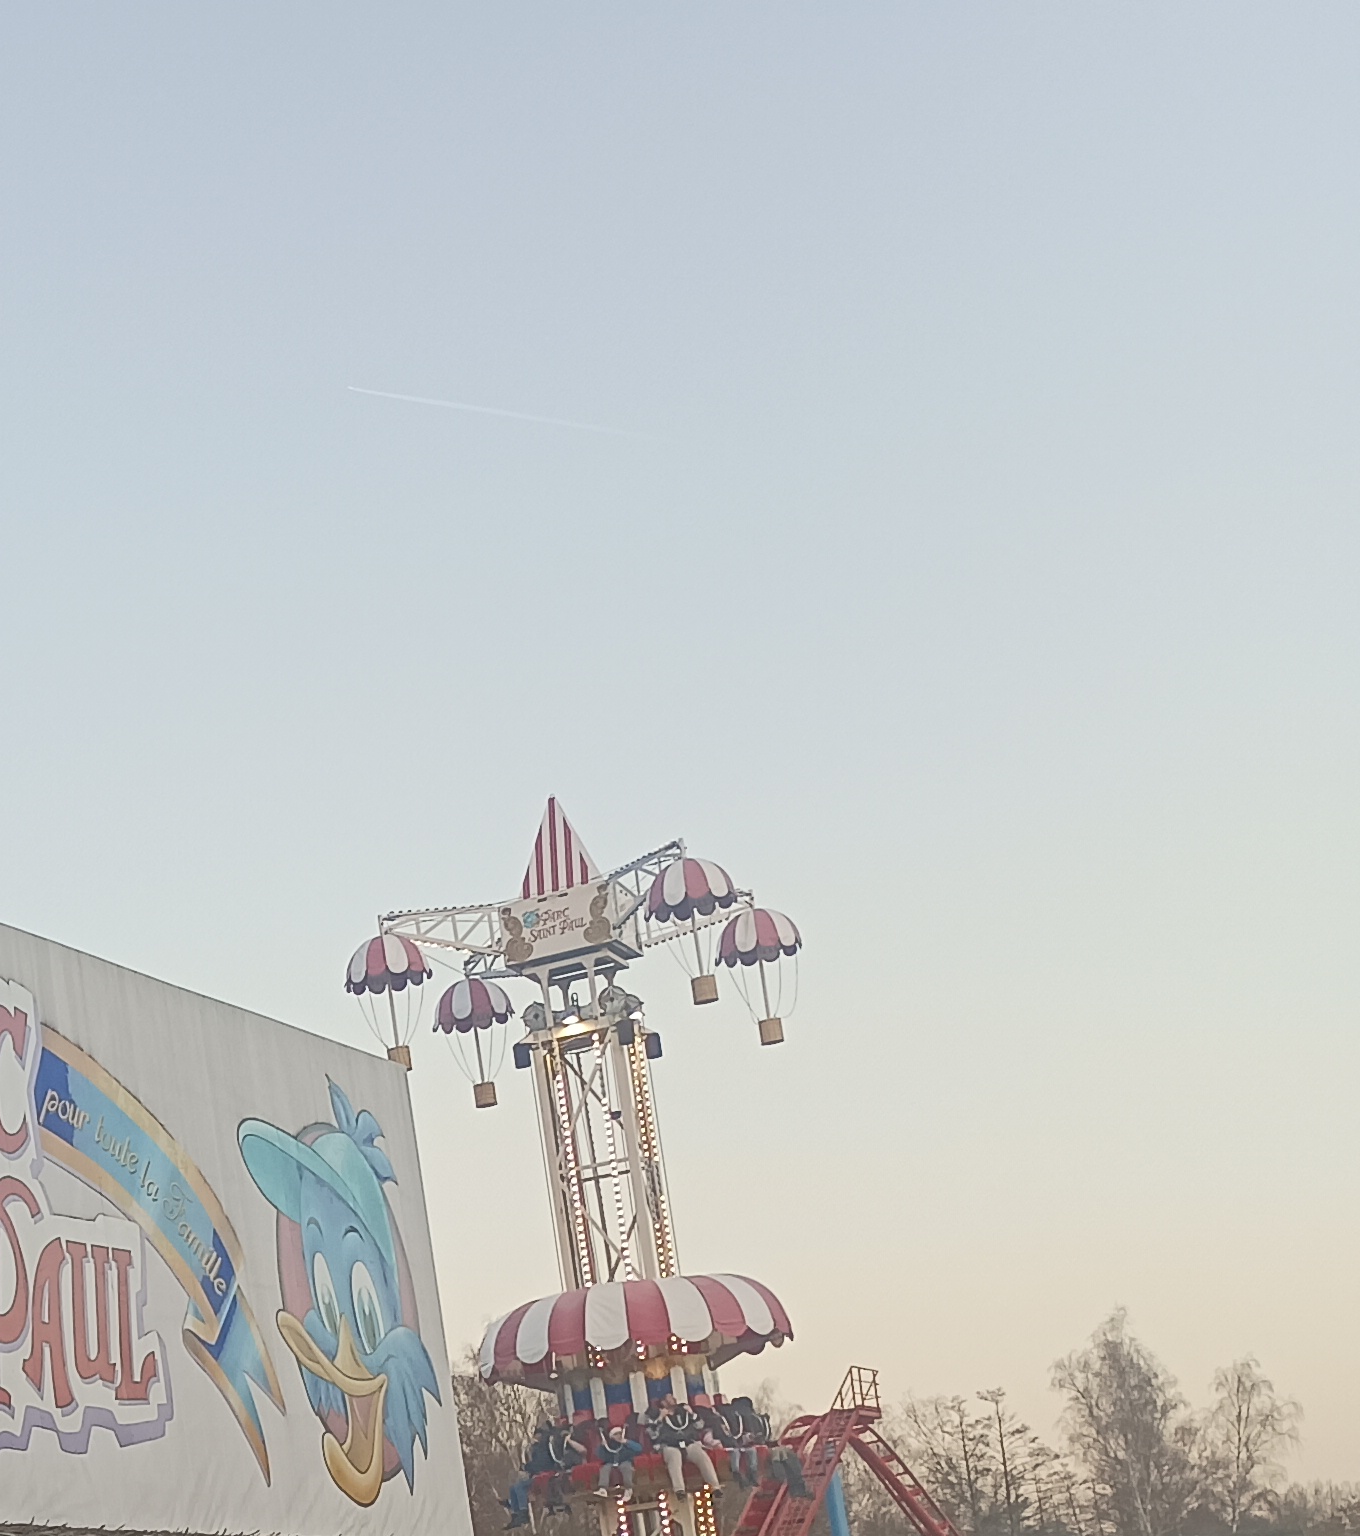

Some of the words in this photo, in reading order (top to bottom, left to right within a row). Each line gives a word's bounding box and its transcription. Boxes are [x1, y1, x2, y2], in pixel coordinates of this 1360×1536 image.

[541, 907, 570, 926] PARC
[529, 924, 557, 942] SAINT
[559, 917, 587, 935] PAUL
[38, 1088, 91, 1130] pour
[94, 1115, 139, 1175] toute
[139, 1160, 161, 1202] la
[162, 1182, 228, 1297] Famille
